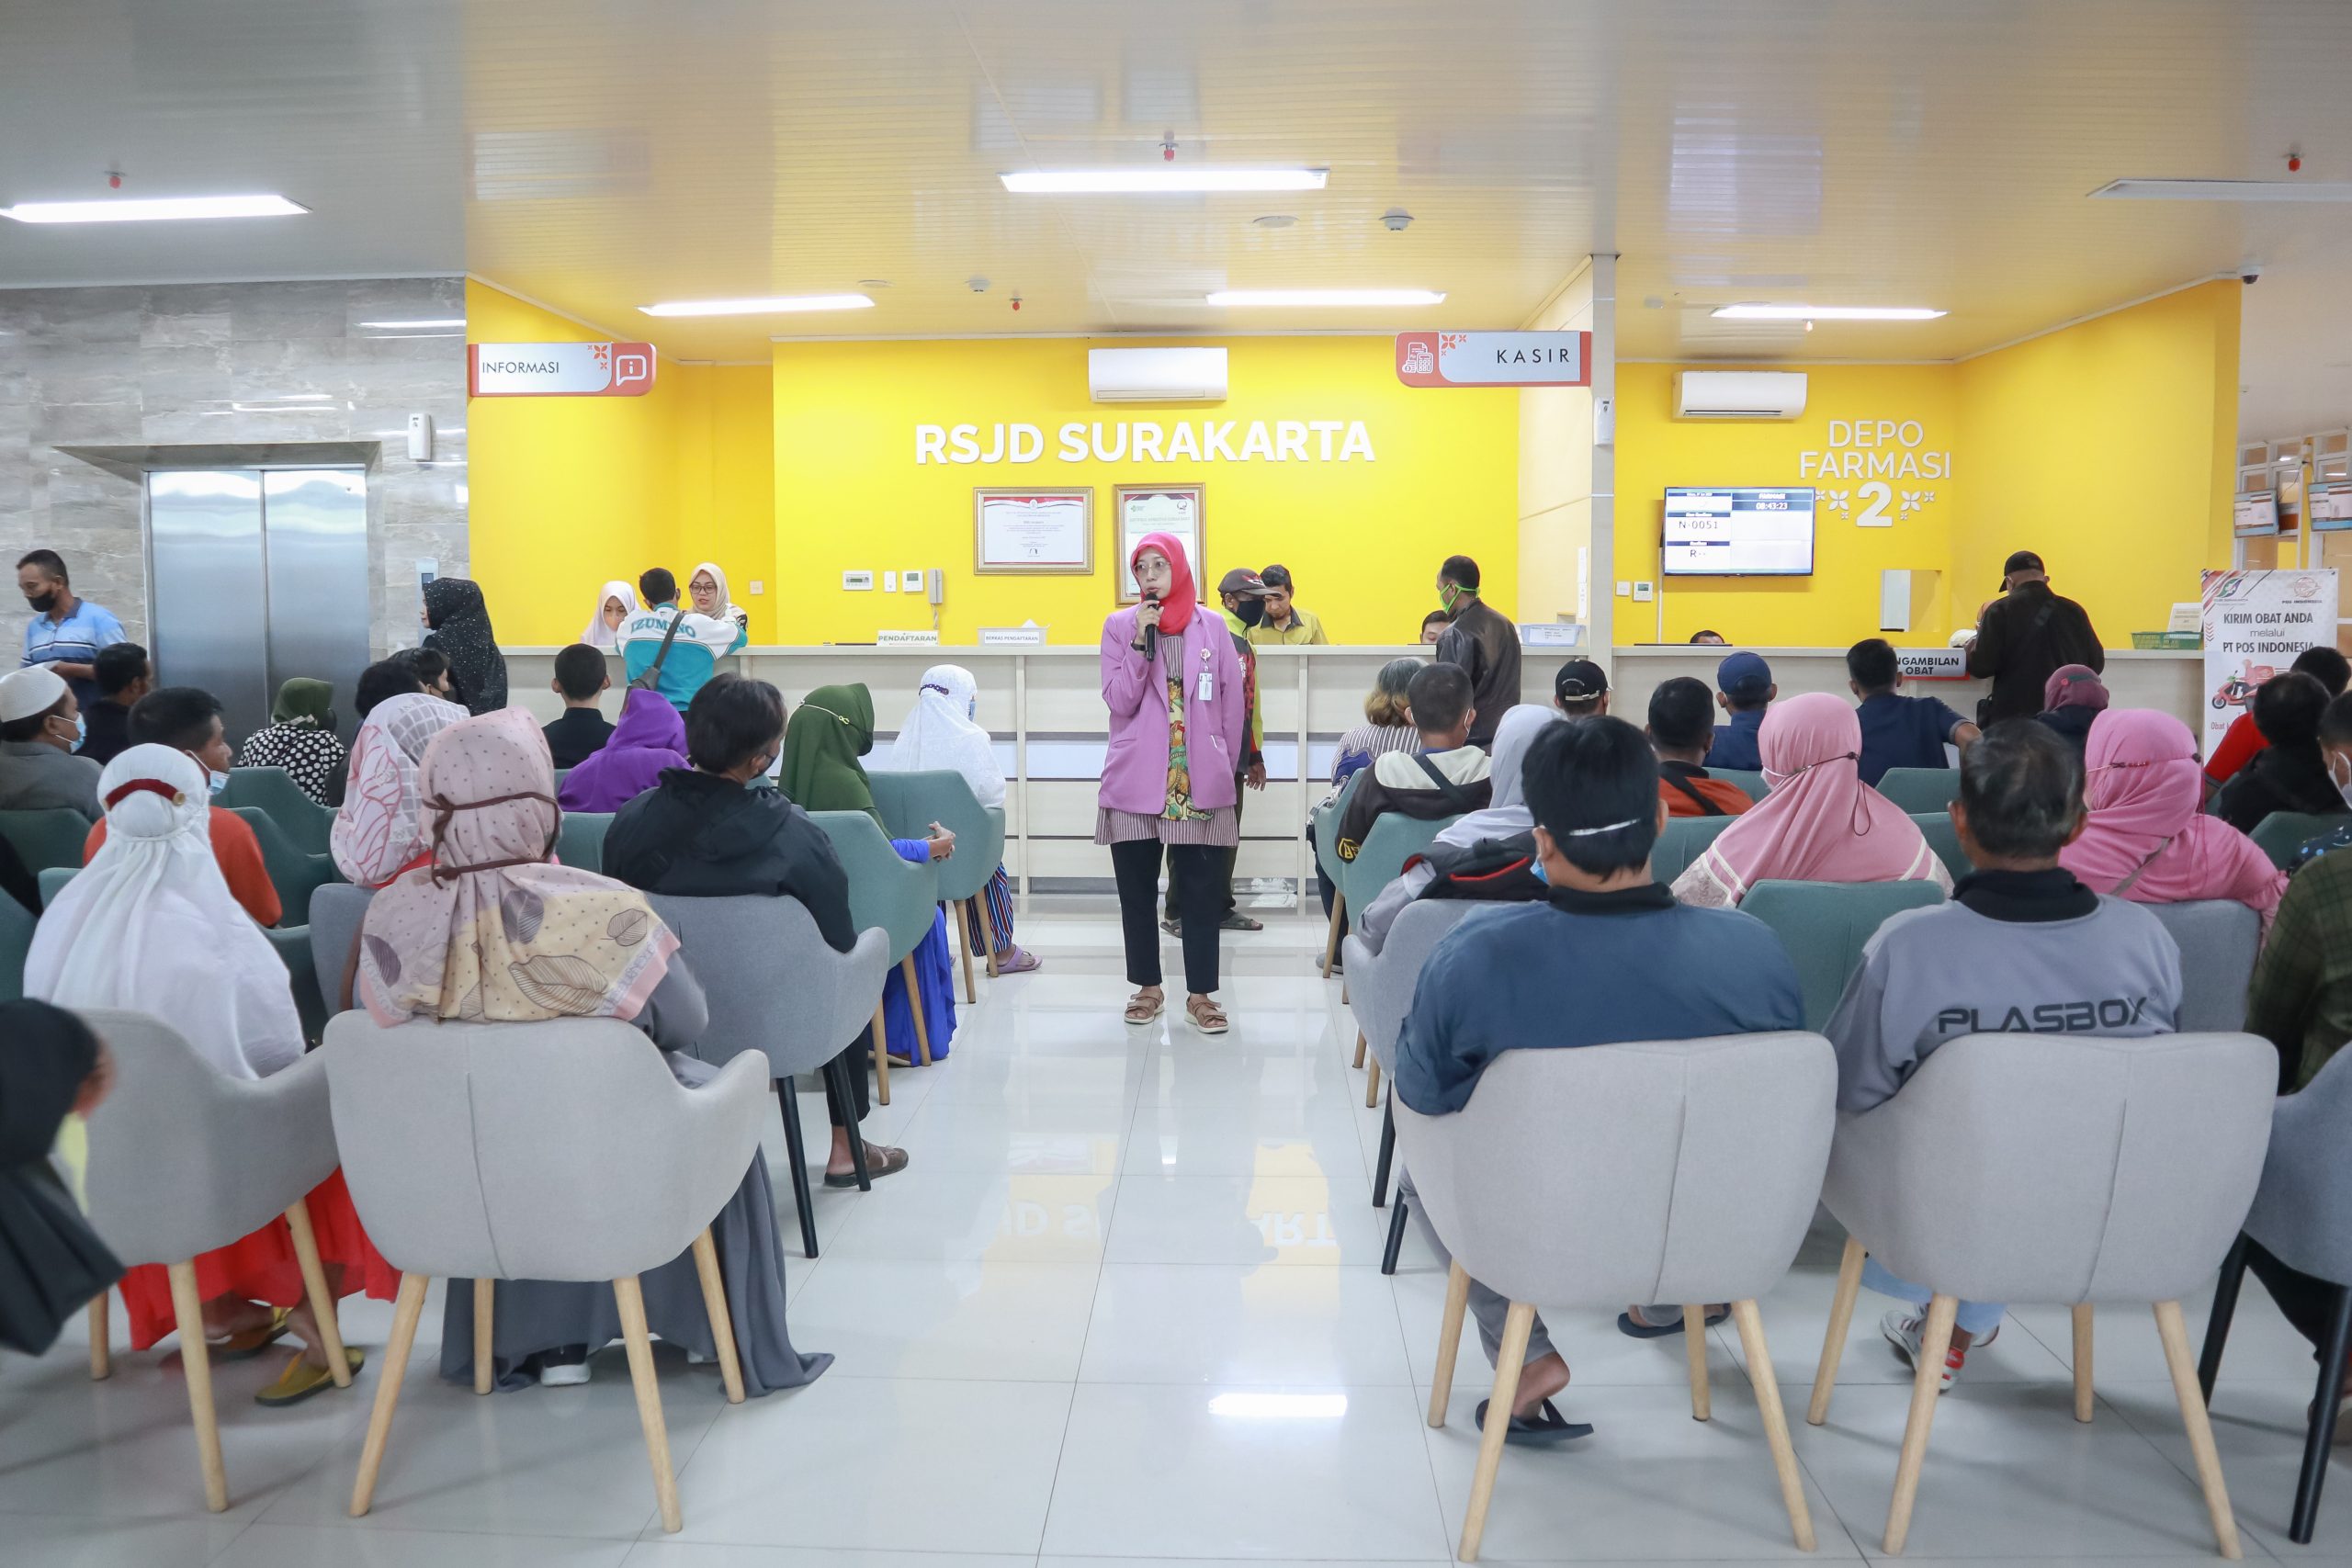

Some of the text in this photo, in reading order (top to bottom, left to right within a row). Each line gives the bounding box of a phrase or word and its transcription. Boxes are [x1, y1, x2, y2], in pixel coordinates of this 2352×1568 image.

[1497, 348, 1570, 363] KASIR
[482, 361, 560, 374] INFORMASI
[1828, 419, 1924, 448] DEPO
[915, 421, 1376, 465] RSJD SURAKARTA
[1799, 450, 1951, 479] FARMASI
[1856, 480, 1894, 527] 2
[2223, 612, 2313, 624] KIRIM OBAT ANDA
[631, 616, 696, 638] IZUMNO
[2250, 628, 2285, 637] melalui
[2223, 642, 2233, 653] PT
[2235, 642, 2256, 653] POS
[1897, 657, 1959, 666] GAMBILAN
[1905, 666, 1934, 675] OBAT
[1938, 997, 2147, 1033] PLASBOX
